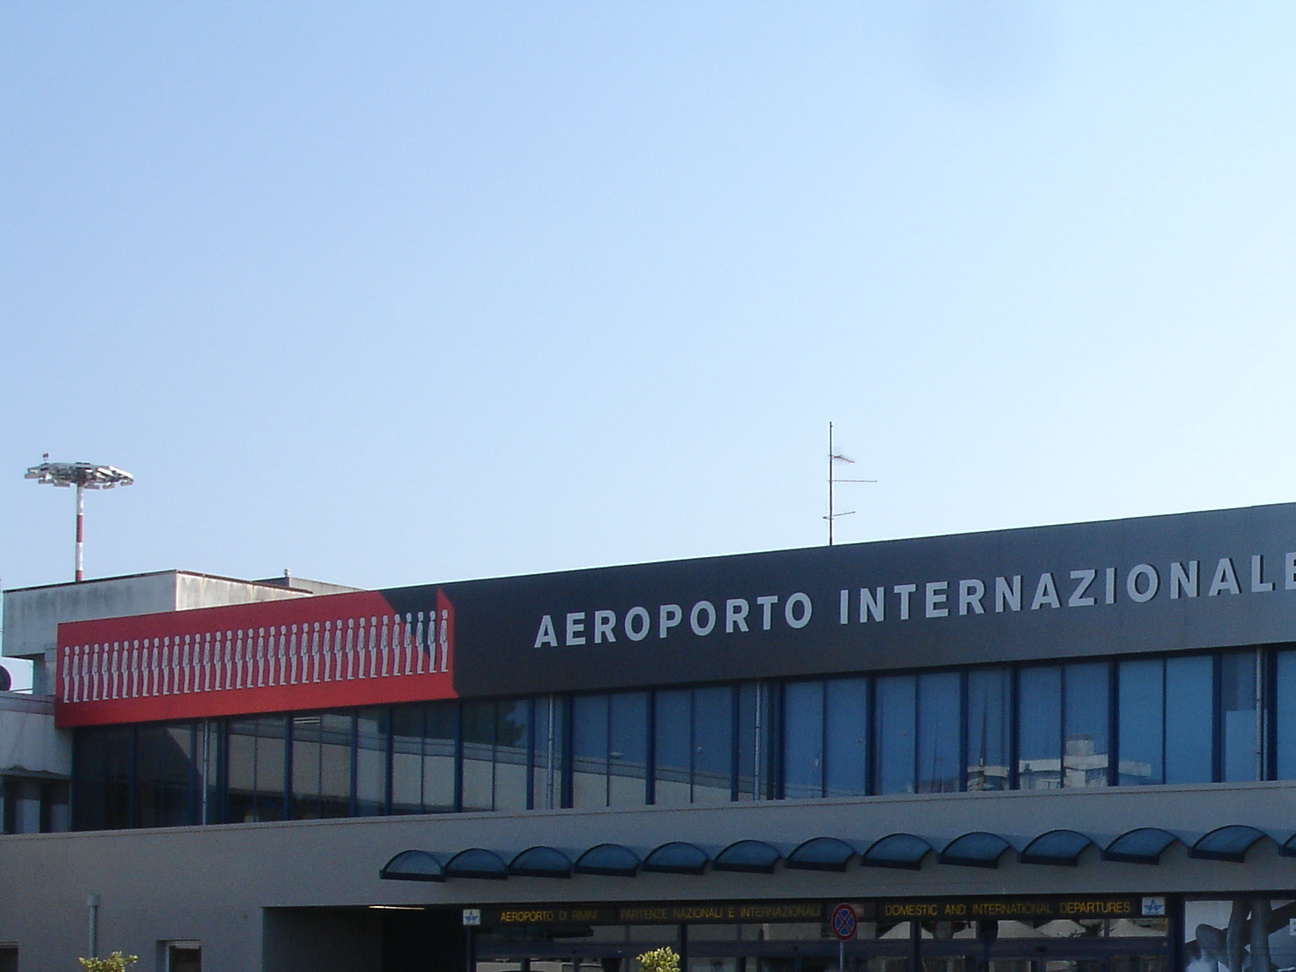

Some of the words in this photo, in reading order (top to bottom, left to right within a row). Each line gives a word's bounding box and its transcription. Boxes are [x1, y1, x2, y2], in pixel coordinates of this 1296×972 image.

[534, 592, 813, 648] AEROPORTO
[500, 911, 554, 922] AEROPORTO
[559, 911, 568, 921] DI
[572, 910, 598, 921] RIMINI
[621, 908, 668, 920] PARTENZE
[673, 907, 723, 919] NAZIONALI
[728, 907, 734, 918] E
[740, 905, 821, 918] INTERNAZIONALI
[885, 904, 937, 916] DOMESTIC
[945, 904, 966, 915] AND
[972, 902, 1053, 915] INTERNATIONAL
[1060, 901, 1131, 914] DEPARTURES
